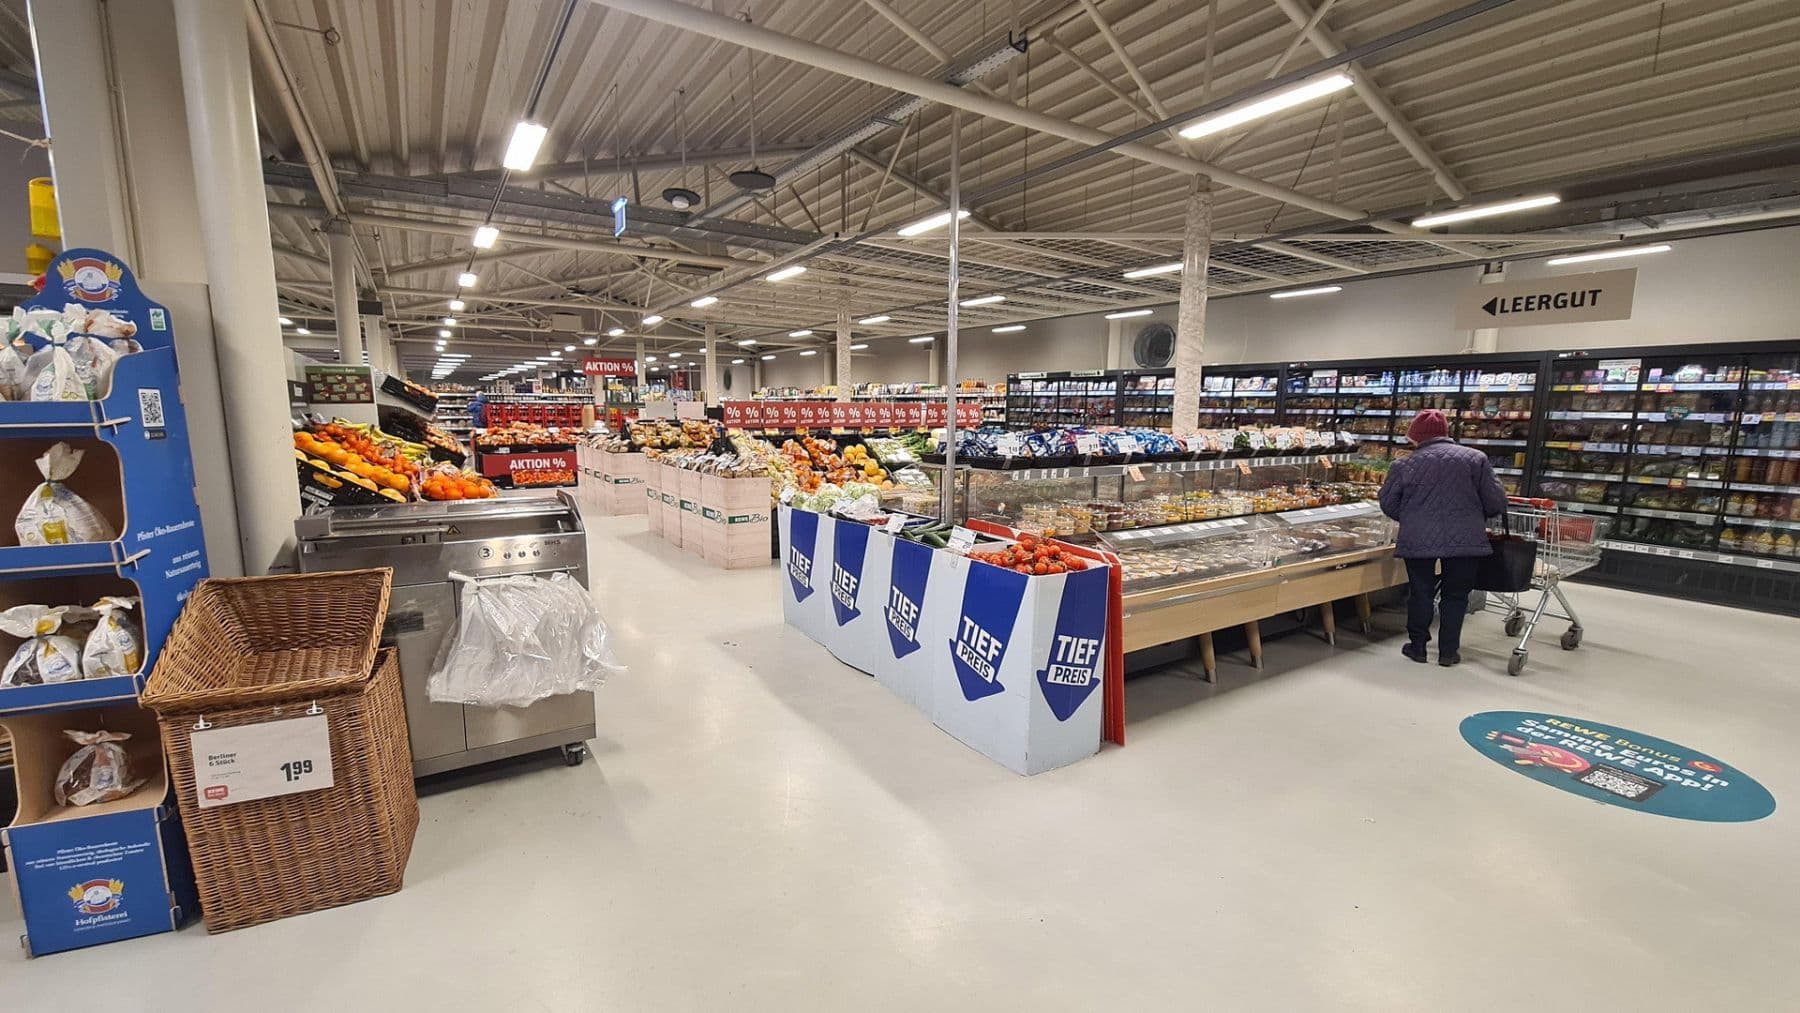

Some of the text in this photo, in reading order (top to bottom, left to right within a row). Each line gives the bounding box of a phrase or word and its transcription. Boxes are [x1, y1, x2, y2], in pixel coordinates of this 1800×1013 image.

[1500, 289, 1602, 314] LEERGUT
[585, 361, 634, 372] AKTION %
[727, 407, 759, 418] % %
[766, 407, 796, 418] % %
[801, 407, 830, 418] % %
[833, 407, 860, 418] % %
[864, 408, 891, 418] % %
[895, 408, 919, 418] % %
[928, 408, 938, 418] %
[956, 408, 978, 418] % %
[509, 457, 566, 470] AKTION %
[750, 513, 769, 523] Bio
[482, 548, 490, 557] 3
[791, 546, 811, 574] TIEF
[834, 562, 858, 594] TIEF
[835, 584, 852, 607] PREIS
[892, 586, 918, 623] TIEF
[891, 611, 912, 638] PREIS
[963, 616, 1003, 661] TIEF
[1057, 635, 1099, 664] TIEF
[960, 646, 991, 679] PREIS
[1054, 668, 1088, 684] PREIS
[1545, 718, 1681, 762] REWE Bonus
[208, 752, 237, 761] Berliner
[1516, 727, 1714, 791] der REWE App!
[1522, 719, 1729, 787] Sammle Euros in
